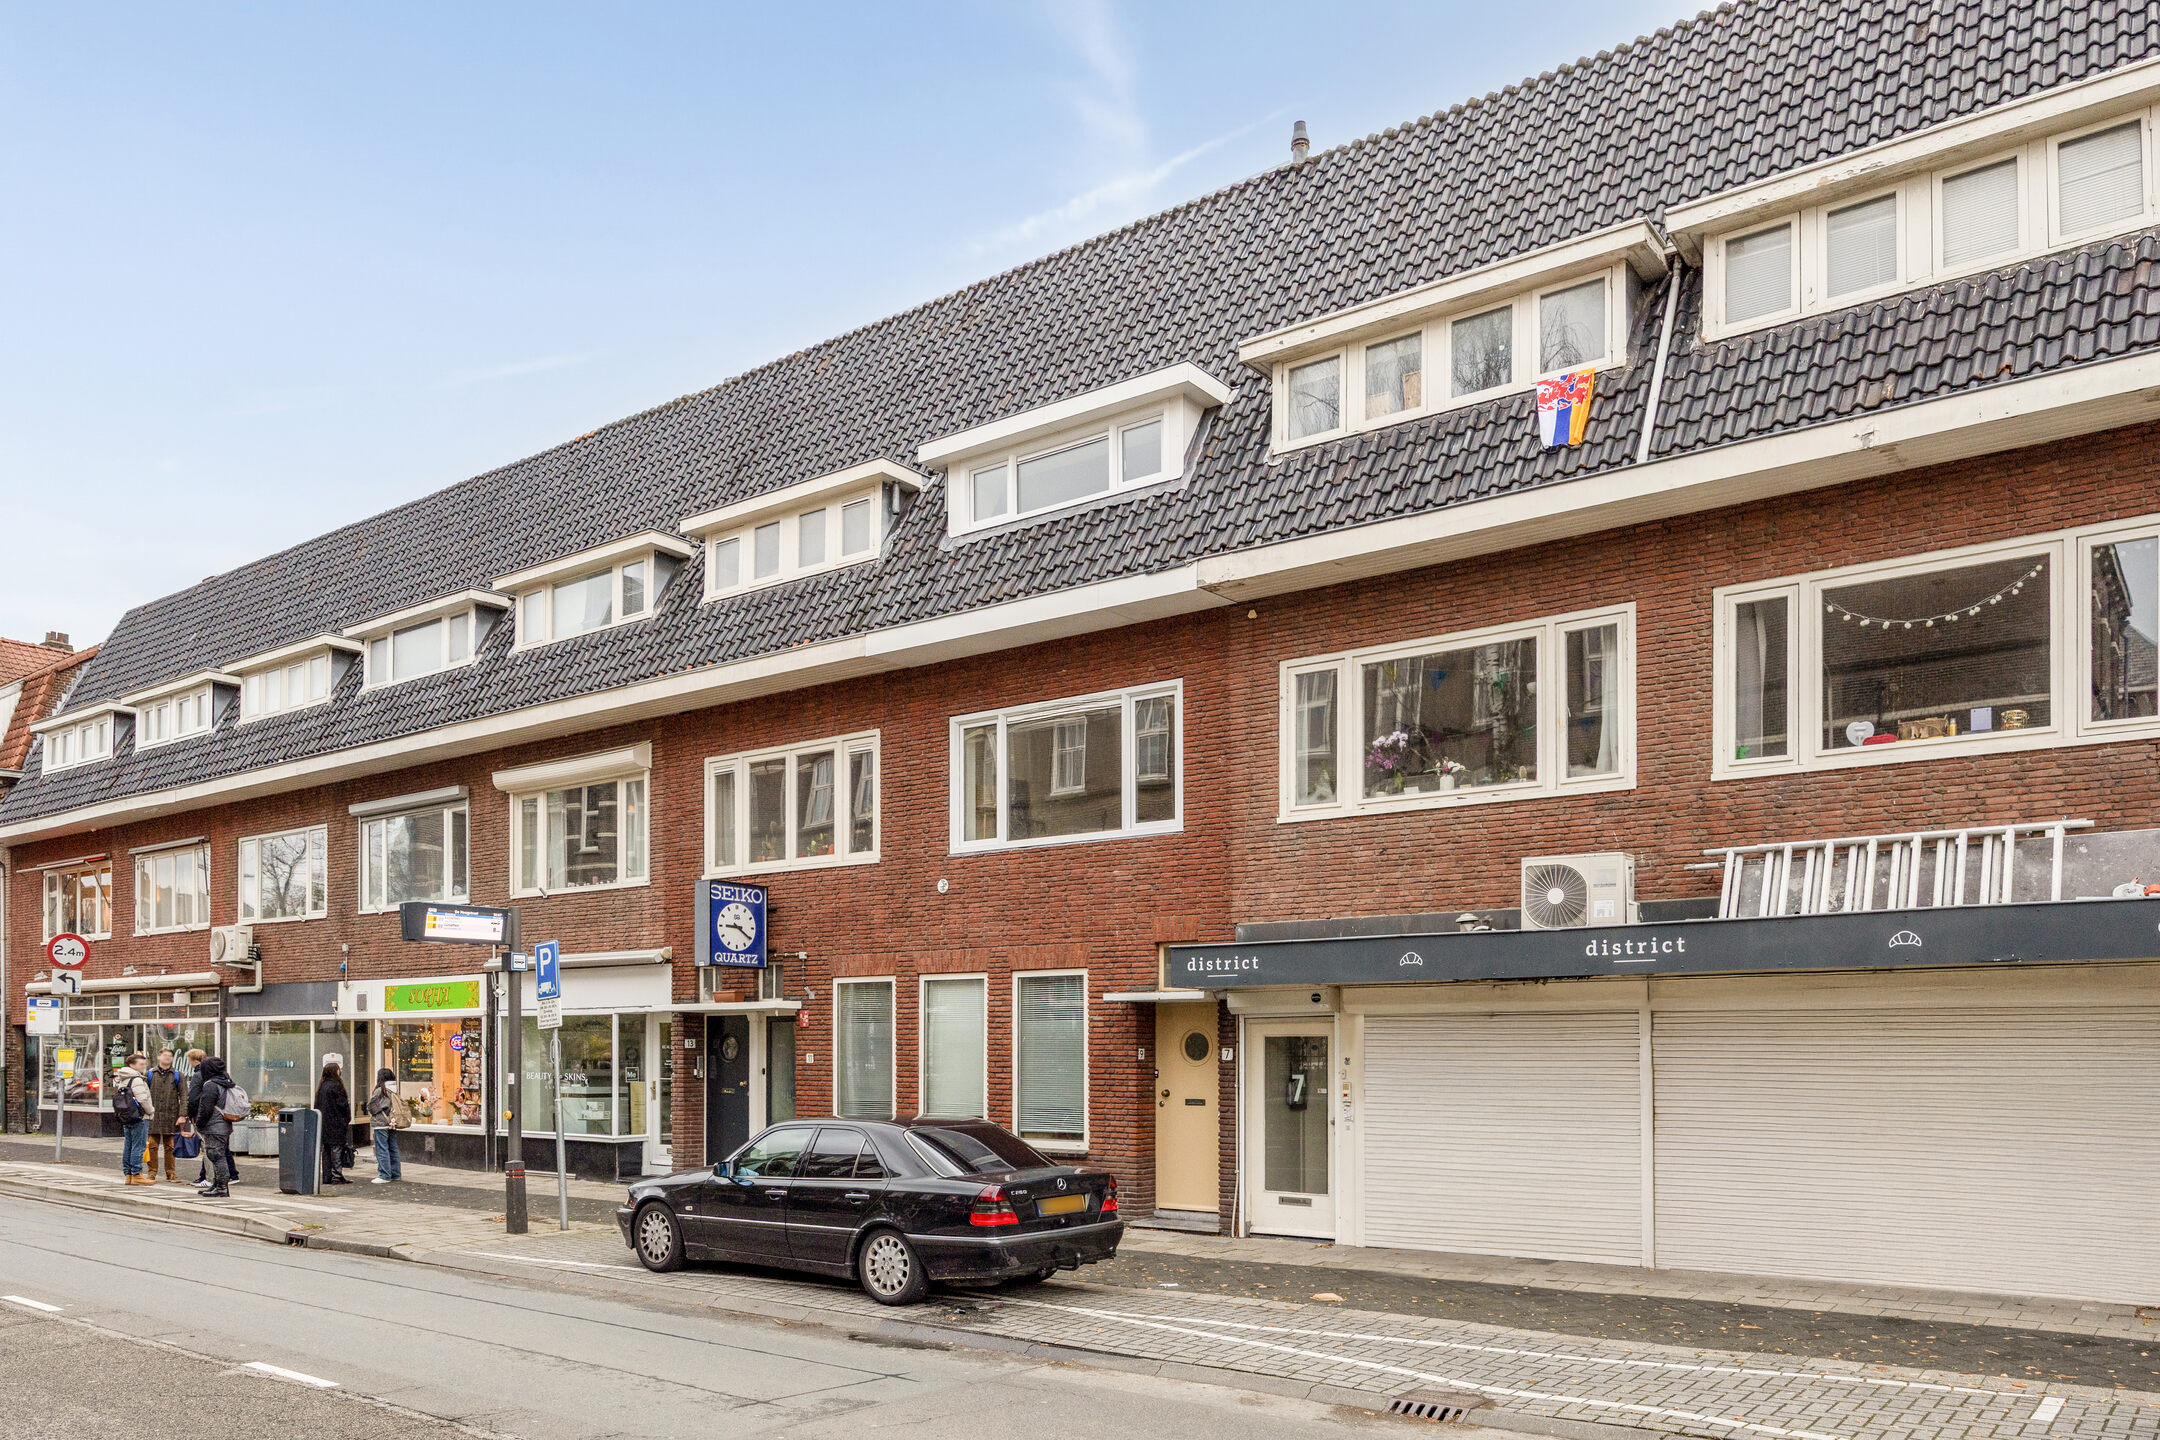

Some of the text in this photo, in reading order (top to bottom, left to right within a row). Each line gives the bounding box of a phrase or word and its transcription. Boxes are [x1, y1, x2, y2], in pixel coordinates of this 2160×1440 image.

[711, 884, 763, 904] SEIKO
[54, 945, 84, 957] 2.4m
[1585, 937, 1686, 956] district
[540, 947, 552, 976] P
[714, 952, 759, 964] QUARTZ
[1187, 955, 1260, 971] district
[451, 1039, 462, 1047] OPE
[1139, 1049, 1144, 1058] 9
[1224, 1049, 1231, 1059] 7
[526, 1071, 552, 1080] BEAUTY
[564, 1072, 586, 1081] SKINS
[626, 1071, 637, 1079] Me
[1292, 1074, 1305, 1102] 7
